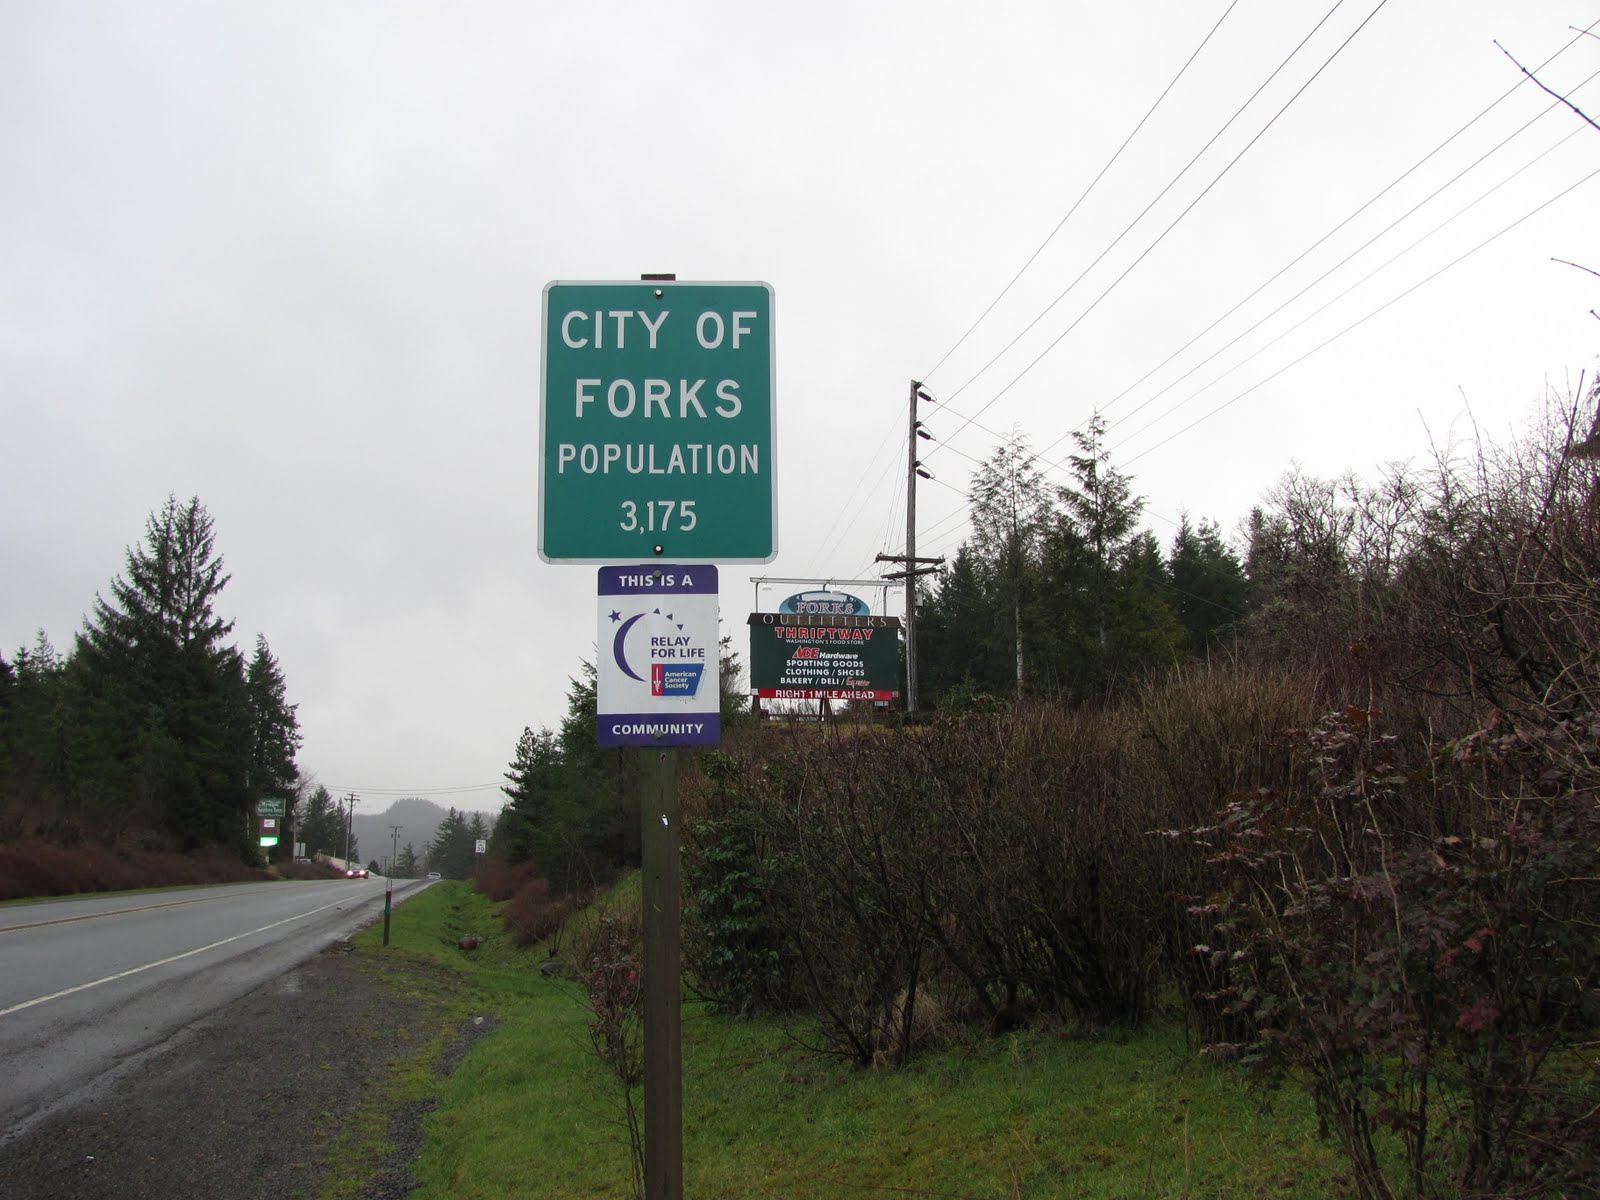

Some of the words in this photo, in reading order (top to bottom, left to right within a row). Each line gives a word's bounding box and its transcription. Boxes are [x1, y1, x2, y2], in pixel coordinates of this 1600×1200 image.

[561, 310, 670, 349] CITY
[696, 311, 757, 349] OF
[575, 378, 742, 418] FORKS
[558, 444, 759, 474] POPULATION
[620, 500, 697, 535] 3,175
[619, 575, 654, 587] THIS
[660, 574, 675, 587] IS
[681, 574, 693, 586] A
[763, 613, 887, 628] OUTFITTERS
[774, 626, 874, 640] THRIFTWAY
[651, 636, 691, 647] RELAY
[651, 648, 676, 658] FOR
[679, 648, 705, 658] LIFE
[792, 645, 820, 659] ACE
[819, 652, 859, 660] Hardware
[832, 660, 864, 668] GOODS
[785, 668, 830, 676] CLOTHING
[664, 682, 690, 690] Society
[775, 689, 807, 698] RIGHT
[808, 690, 813, 698] 1
[814, 690, 839, 699] MILE
[840, 690, 875, 699] AHEAD
[612, 723, 704, 735] COMMUNITY
